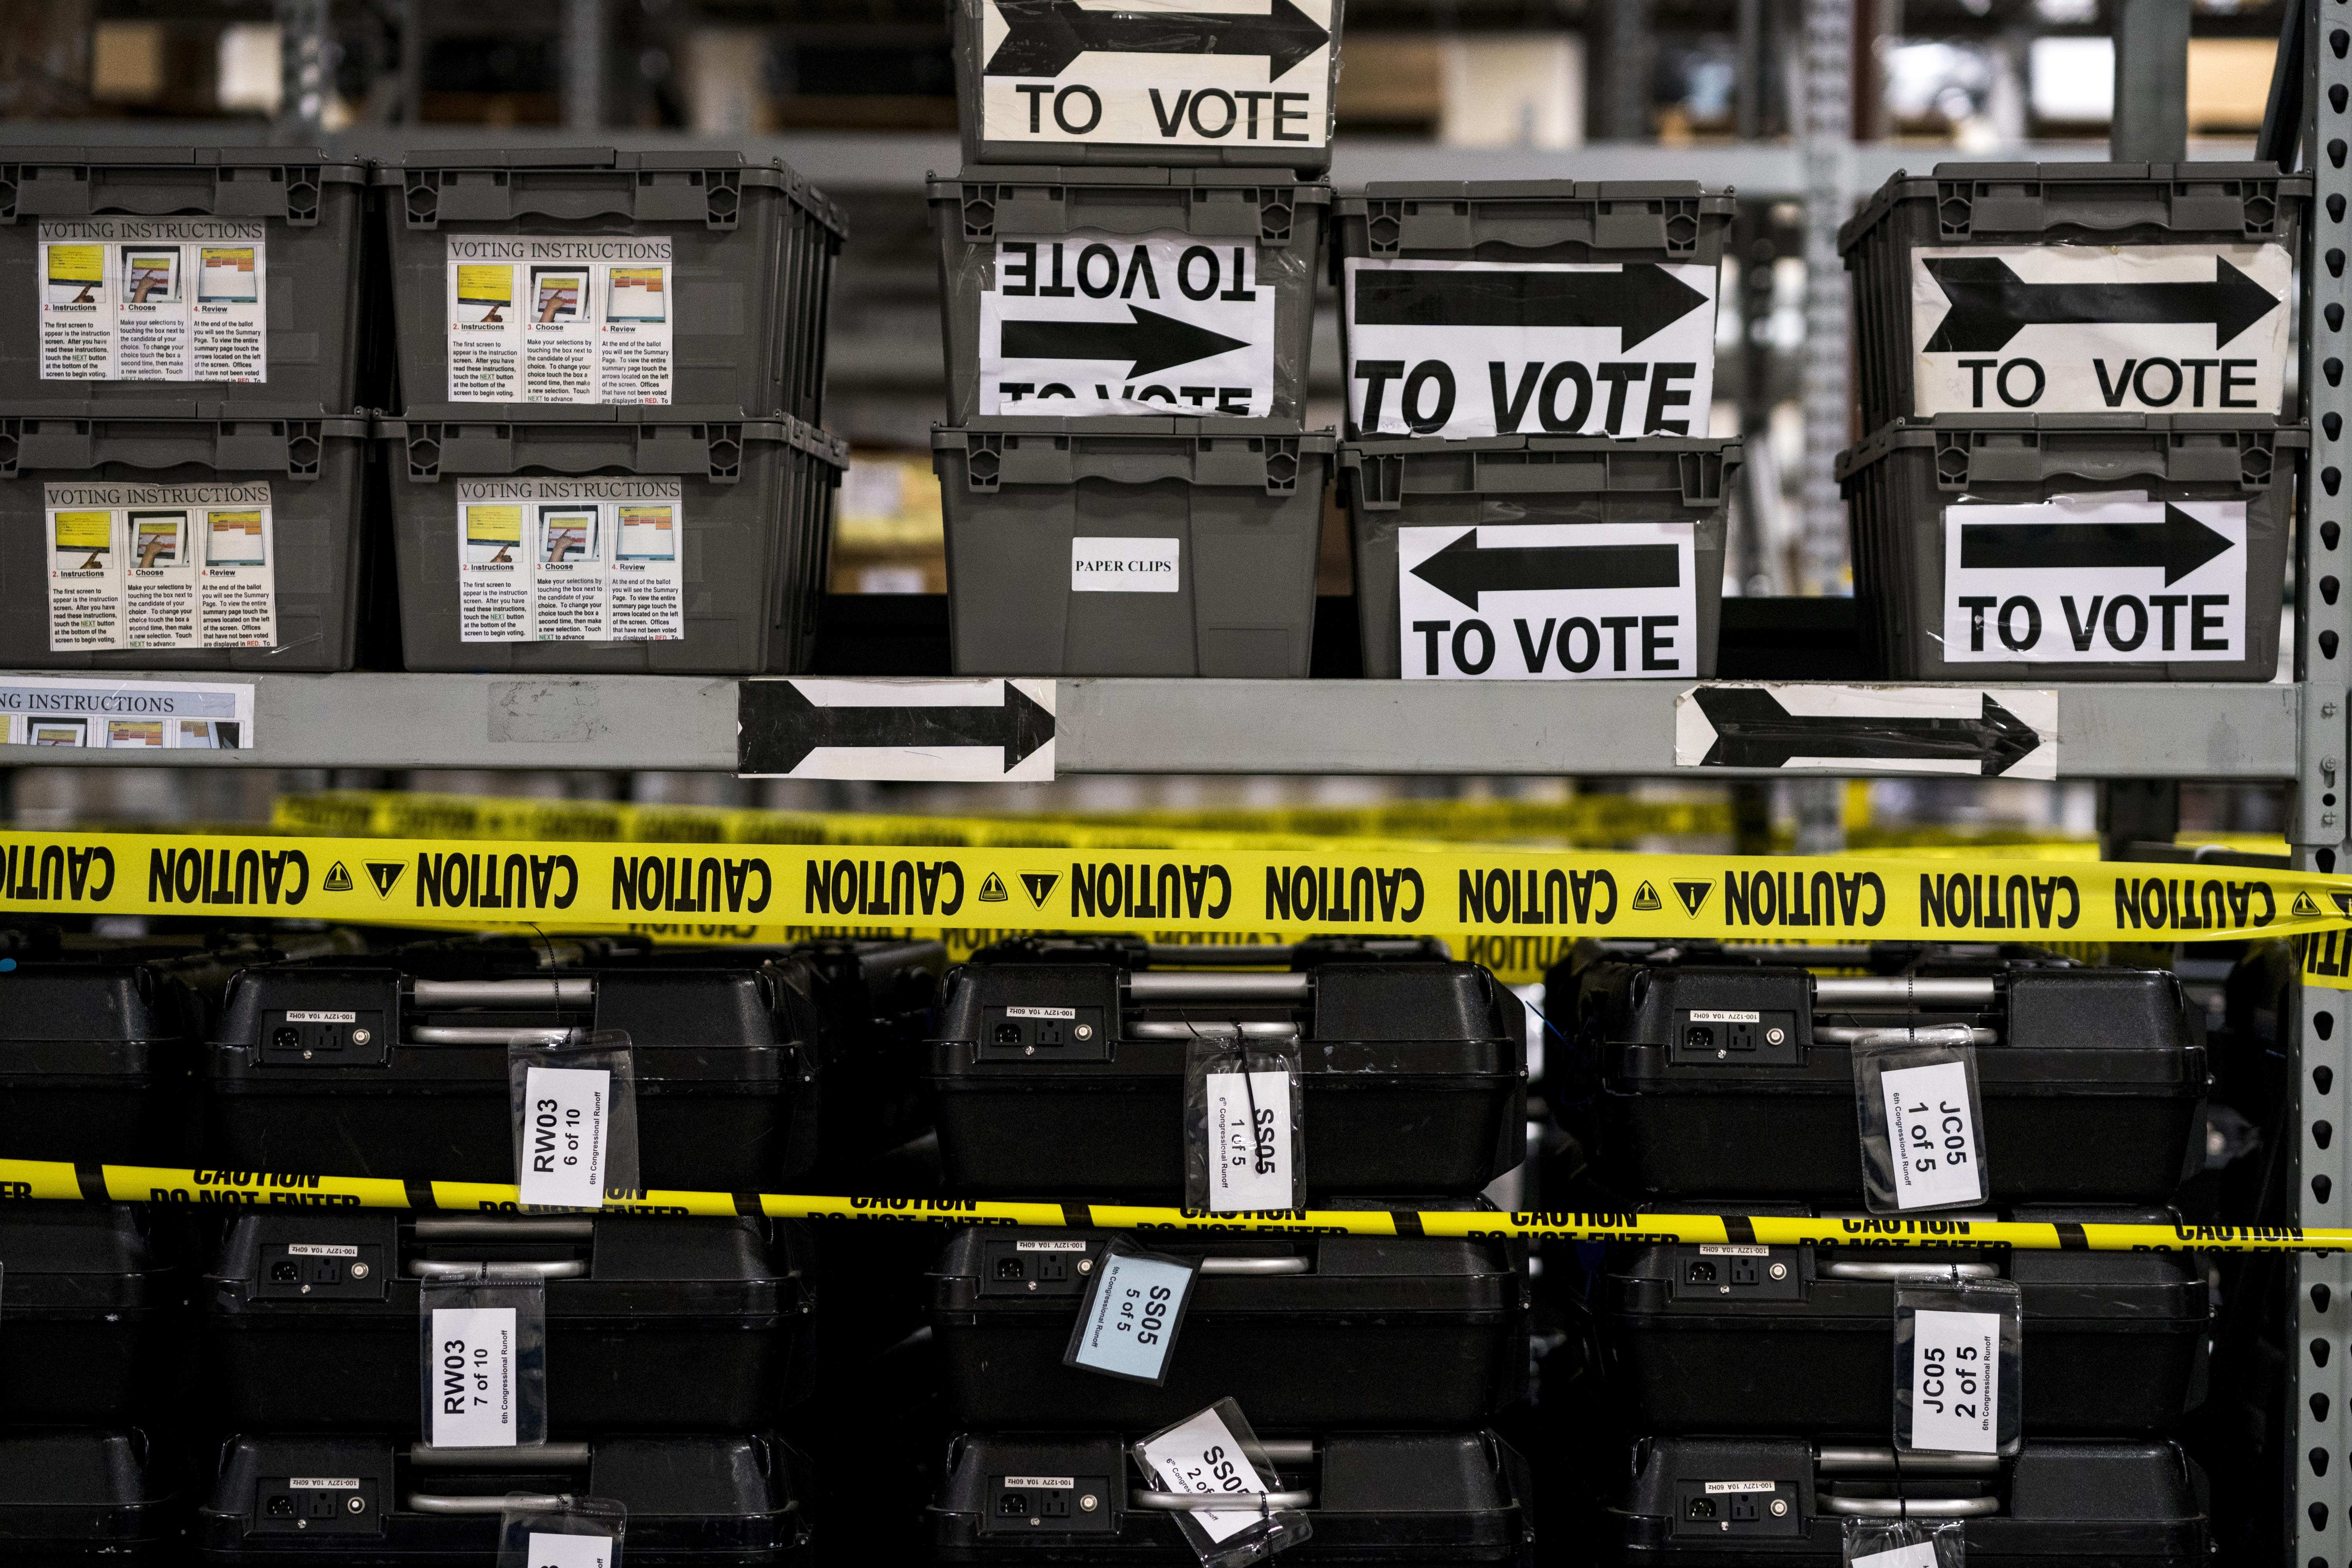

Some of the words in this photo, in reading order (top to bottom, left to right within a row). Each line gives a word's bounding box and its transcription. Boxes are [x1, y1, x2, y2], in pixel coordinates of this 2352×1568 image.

[1016, 85, 1102, 134] TO
[1149, 88, 1309, 141] VOTE
[40, 222, 114, 238] VOTING
[121, 222, 262, 238] INSTRUCTIONS
[452, 242, 524, 258] VOTING
[531, 243, 671, 258] INSTRUCTIONS
[1002, 241, 1160, 299] VOTE
[1177, 246, 1256, 301] TO
[461, 323, 505, 331] Instructions
[1355, 359, 1456, 434] TO
[1488, 360, 1697, 436] VOTE
[1958, 358, 2045, 408] TO
[2093, 358, 2257, 408] VOTE
[48, 488, 120, 505] VOTING
[127, 486, 269, 503] INSTRUCTIONS
[460, 483, 532, 499] VOTING
[539, 482, 680, 497] INSTRUCTIONS
[1076, 561, 1123, 571] PAPER
[1128, 561, 1171, 571] CLIPS
[1413, 619, 1495, 675] TO
[1514, 616, 1679, 673] VOTE
[1959, 595, 2042, 652] TO
[2060, 595, 2229, 652] VOTE
[29, 694, 174, 712] INSTRUCTIONS
[0, 845, 115, 902] CAUTI
[148, 848, 309, 905] CAUTION
[416, 853, 578, 909] CAUTION
[612, 857, 771, 913] CAUTION
[806, 860, 964, 916] CAUTION
[1072, 862, 1232, 920] CAUTION
[1266, 866, 1425, 923] CAUTION
[1459, 869, 1617, 924] CAUTION
[1726, 871, 1885, 926] CAUTION
[1921, 873, 2080, 929] CAUTION
[2116, 878, 2276, 929] CAUTION
[566, 1109, 580, 1127] 10
[1909, 1102, 1929, 1112] 1
[534, 1099, 557, 1172] RW03
[565, 1132, 579, 1150] of
[591, 1118, 599, 1171] Congressional
[1219, 1108, 1227, 1161] Congressional
[1255, 1109, 1275, 1174] SS05
[1895, 1106, 1906, 1159] Congressional
[1902, 1161, 1911, 1185] Runoff
[1911, 1125, 1934, 1149] of
[1940, 1101, 1967, 1165] JC05
[193, 1170, 320, 1188] CAUTION
[564, 1156, 577, 1165] 6
[1232, 1156, 1246, 1165] 5
[1916, 1159, 1936, 1172] 5
[1098, 1276, 1116, 1323] Congressional
[1121, 1302, 1134, 1319] of
[1126, 1289, 1140, 1298] 5
[1138, 1286, 1171, 1345] SS05
[1091, 1325, 1103, 1347] Runoff
[1117, 1322, 1131, 1331] 5
[444, 1340, 465, 1414] RW03
[474, 1349, 488, 1367] 10
[1956, 1347, 1977, 1361] 5
[474, 1373, 488, 1390] of
[474, 1397, 487, 1406] 7
[1923, 1348, 1945, 1413] JC05
[1956, 1368, 1976, 1394] of
[1955, 1404, 1975, 1418] 2
[1187, 1468, 1201, 1480] 2
